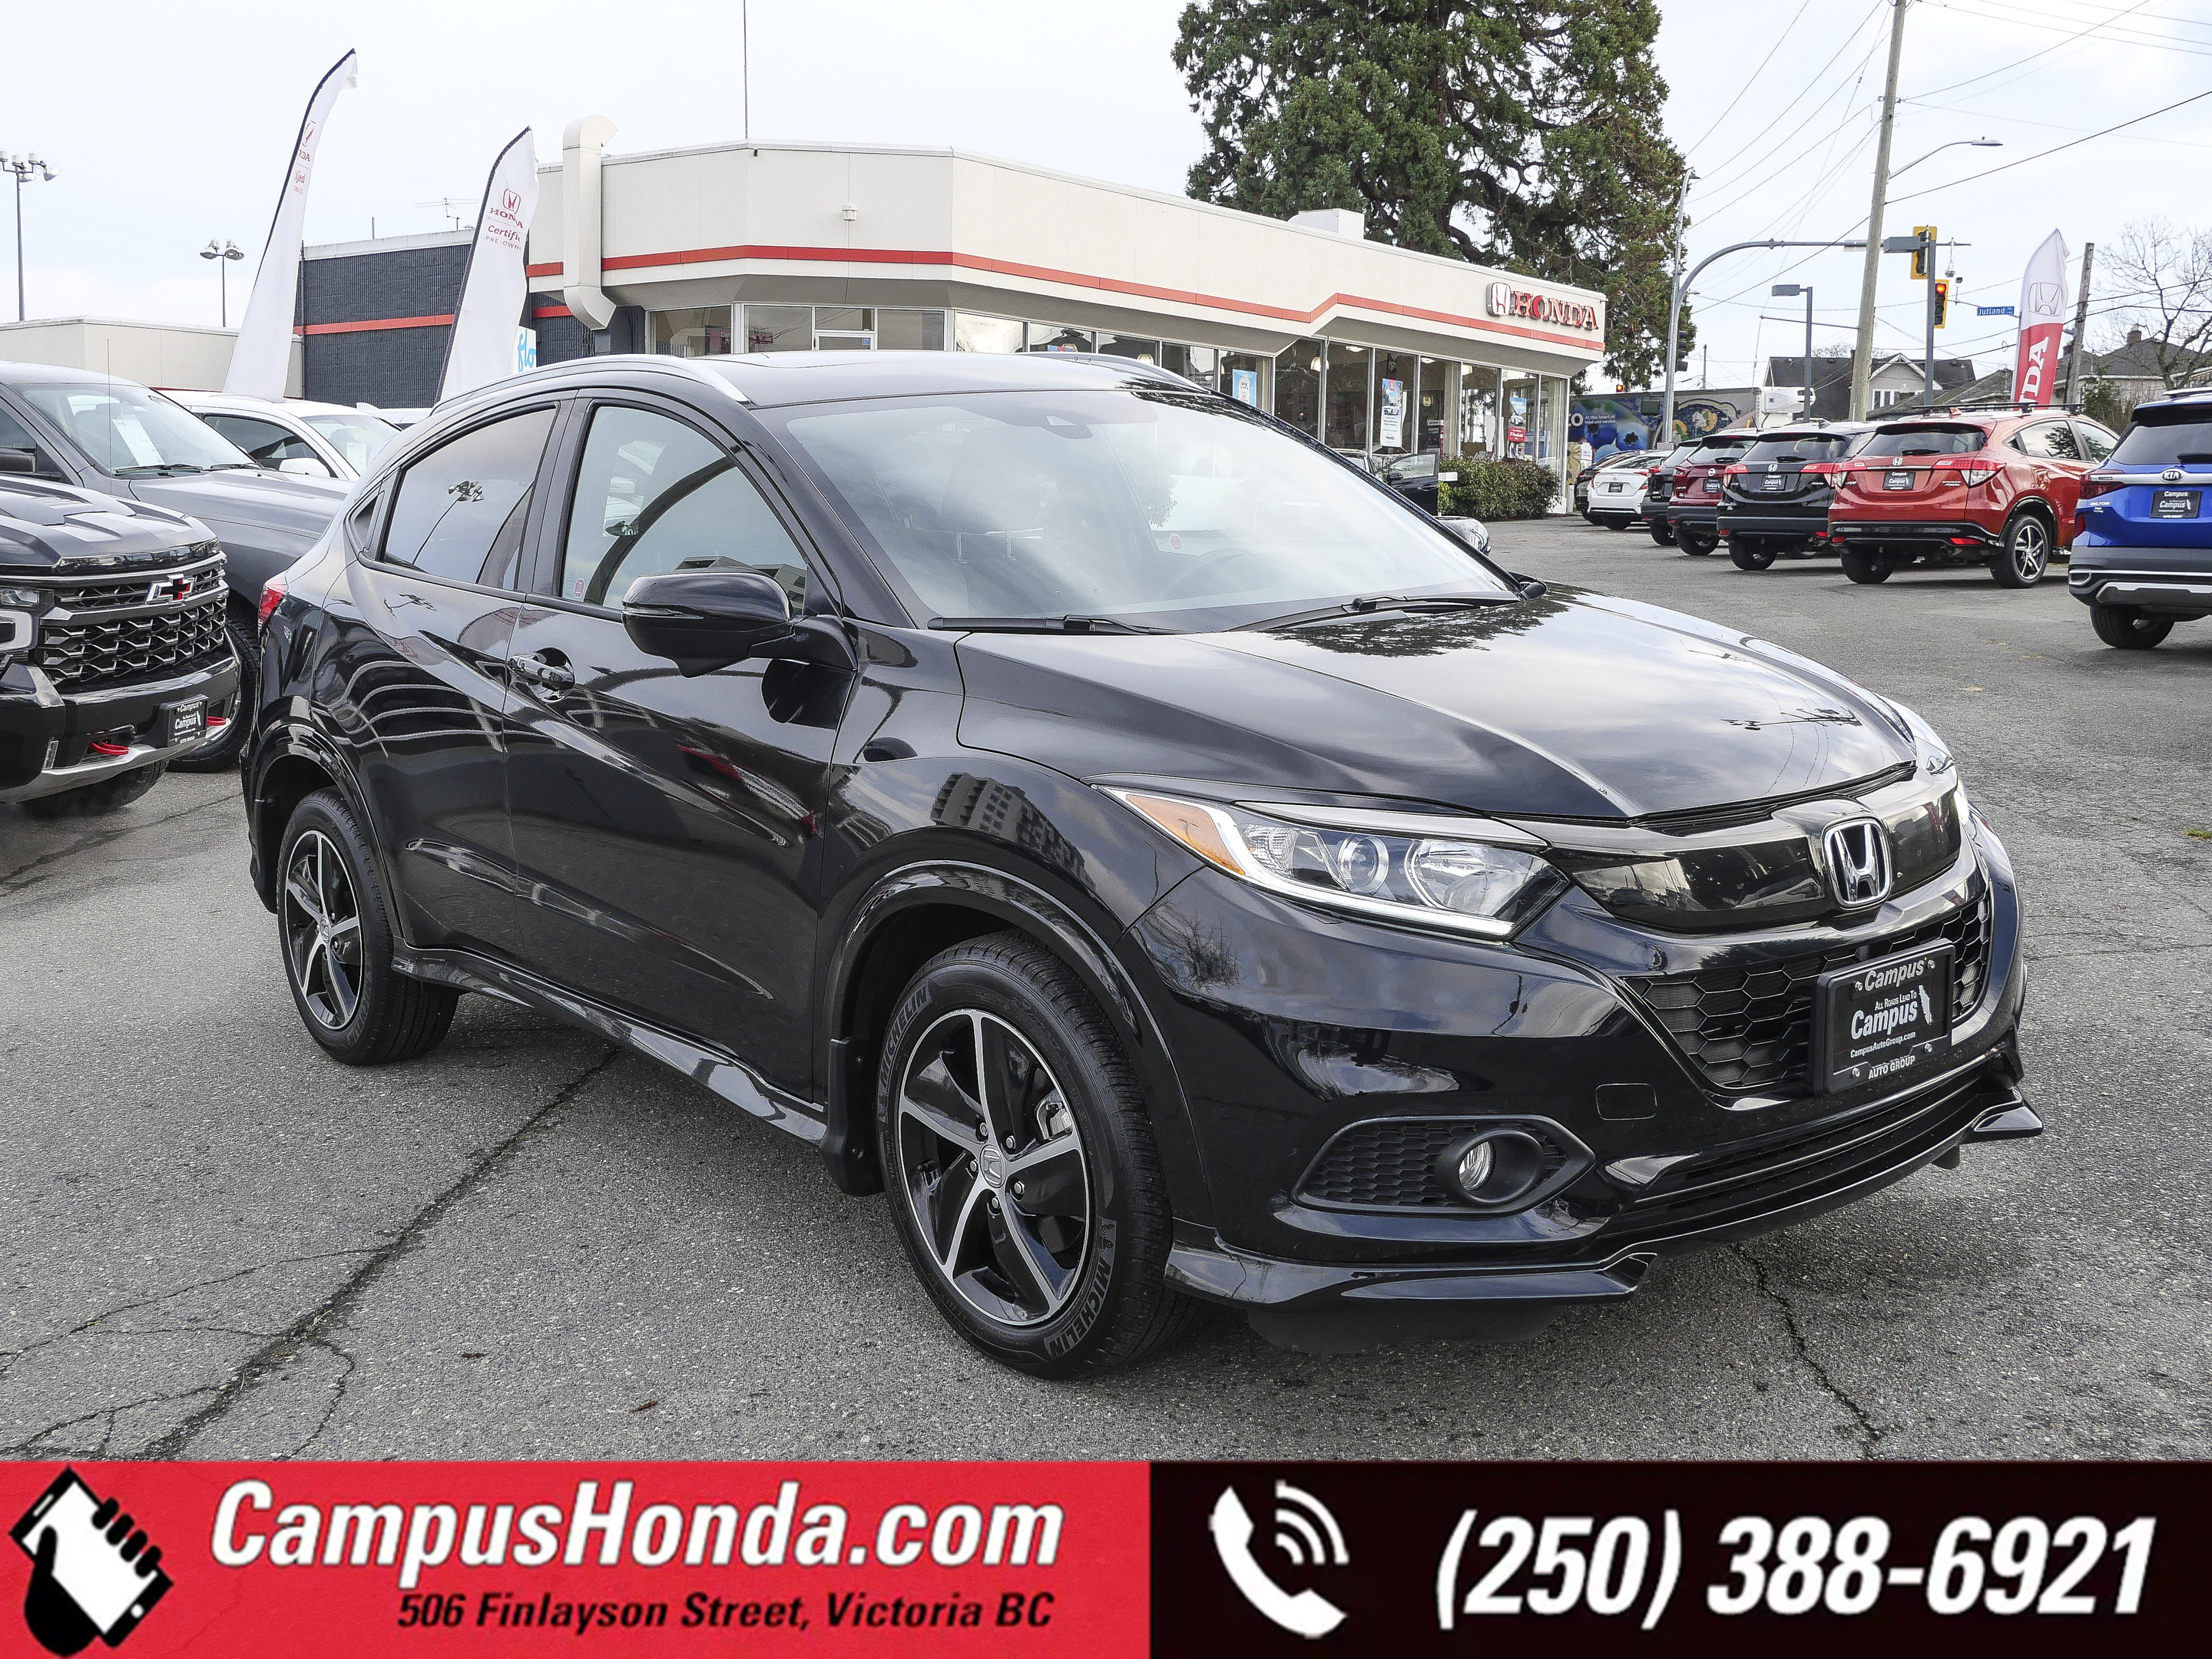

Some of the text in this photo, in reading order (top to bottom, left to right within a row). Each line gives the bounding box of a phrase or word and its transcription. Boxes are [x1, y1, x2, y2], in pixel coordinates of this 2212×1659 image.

[489, 207, 524, 229] HONA
[485, 236, 522, 250] PRE-OWN
[488, 225, 520, 242] Certifi
[1513, 290, 1599, 330] HONDA
[2164, 471, 2181, 480] KIA
[2159, 500, 2186, 509] Campus
[180, 702, 199, 712] Campus
[175, 717, 197, 729] Campus
[1864, 960, 1925, 992] Campus
[1851, 1001, 1918, 1040] Campus
[879, 984, 928, 1089] MICHELIN
[1850, 1031, 1916, 1058] CampusAutoGroup.com
[1868, 1055, 1916, 1080] AUTO GROUP
[1049, 1255, 1112, 1357] MICHELIN
